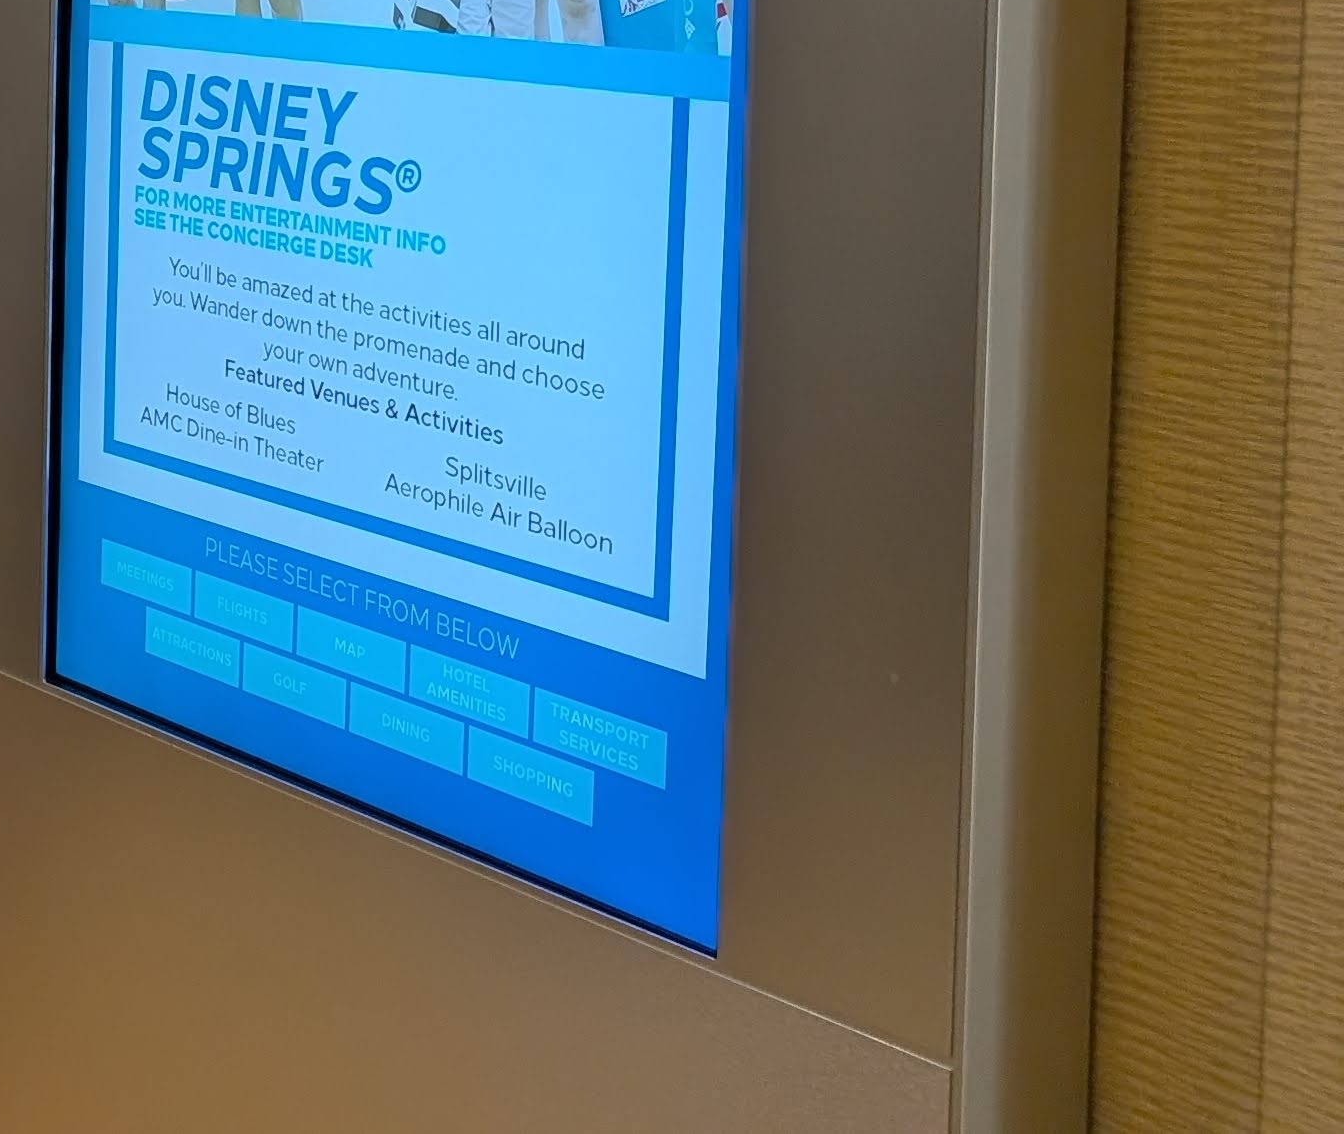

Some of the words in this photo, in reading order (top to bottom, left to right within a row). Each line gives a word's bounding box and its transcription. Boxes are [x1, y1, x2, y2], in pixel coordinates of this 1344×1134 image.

[139, 68, 358, 145] DISNEY
[134, 185, 169, 208] FOR
[172, 189, 227, 217] MORE
[230, 197, 391, 246] ENTERTAINMENT
[395, 228, 447, 256] INFO
[134, 207, 166, 230] SEE
[169, 211, 204, 236] THE
[207, 219, 316, 258] CONCIERGE
[320, 240, 374, 269] DESK
[169, 256, 212, 284] You'll
[216, 264, 238, 289] be
[242, 268, 313, 304] amazed
[317, 284, 337, 307] at
[341, 286, 375, 315] the
[379, 293, 472, 338] activities
[476, 316, 501, 345] all
[505, 324, 586, 362] around
[152, 287, 187, 310] you.
[190, 290, 259, 324] Wander
[261, 305, 313, 338] down
[316, 316, 349, 346] the
[353, 329, 471, 372] promenade
[475, 352, 517, 382] and
[521, 362, 606, 402] choose
[263, 341, 305, 369] your
[308, 348, 348, 377] own
[352, 356, 459, 402] adventure.
[166, 382, 220, 415] House
[223, 396, 244, 420] of
[247, 402, 297, 436] Blues
[224, 359, 305, 397] Featured
[311, 379, 381, 418] Venues
[385, 398, 400, 422] &
[404, 402, 504, 447] Activities
[139, 405, 183, 436] AMC
[186, 418, 250, 454] Dine-in
[253, 435, 325, 473] Theater
[444, 456, 547, 502] Splitsville
[384, 472, 484, 522] Aerophile
[489, 501, 524, 529] Air
[527, 511, 613, 556] Balloon
[116, 560, 175, 593] MEETINGS
[204, 536, 279, 582] PLEASE
[283, 561, 361, 607] SELECT
[364, 590, 431, 630] FROM
[436, 612, 520, 661] BELOW
[216, 595, 268, 626] FLIGHTS
[152, 625, 233, 668] ATTRACTIONS
[333, 636, 367, 660] MAP
[273, 672, 308, 697] GOLF
[426, 681, 506, 722] AMENITIES
[442, 663, 490, 694] HOTEL
[380, 712, 431, 744] DINING
[550, 702, 649, 751] TRANSPORT
[558, 729, 640, 771] SERVICES
[492, 754, 574, 798] SHOPPING
